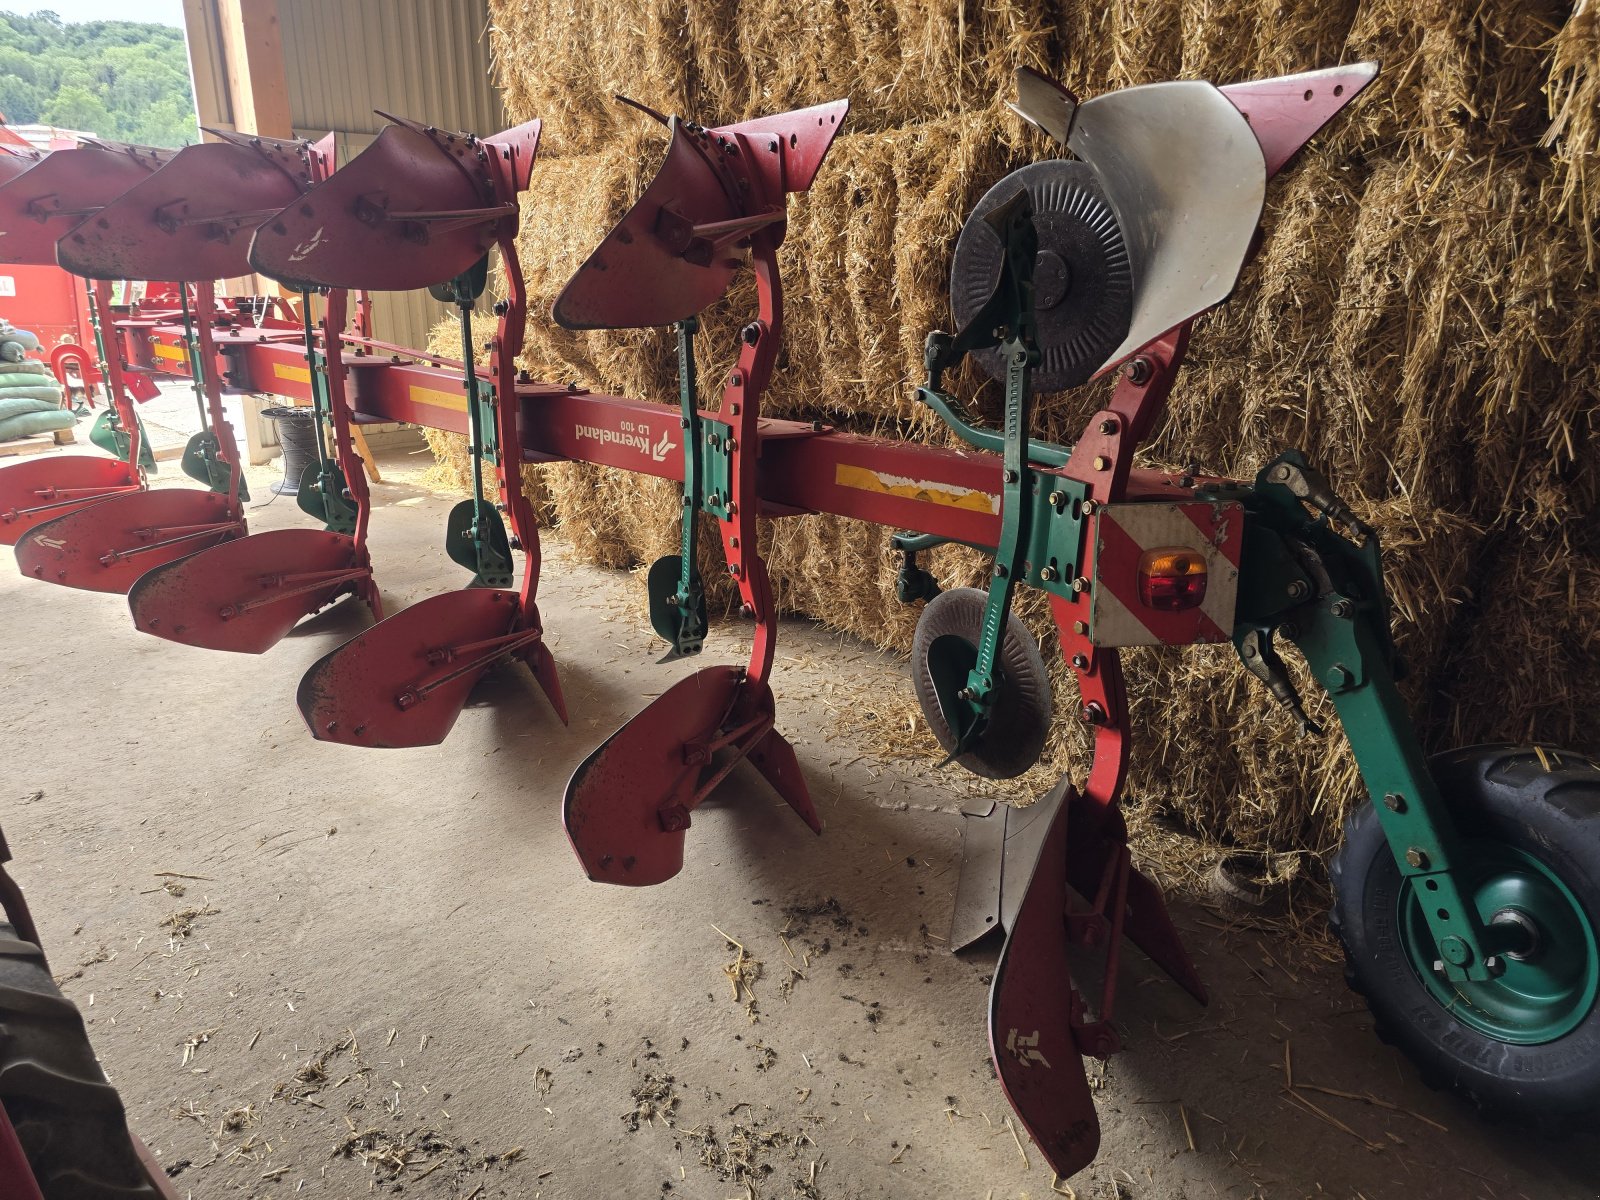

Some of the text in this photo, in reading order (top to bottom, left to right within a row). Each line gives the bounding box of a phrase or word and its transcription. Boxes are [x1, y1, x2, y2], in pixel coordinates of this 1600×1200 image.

[575, 424, 650, 455] Kverneland
[620, 420, 650, 436] LD 100
